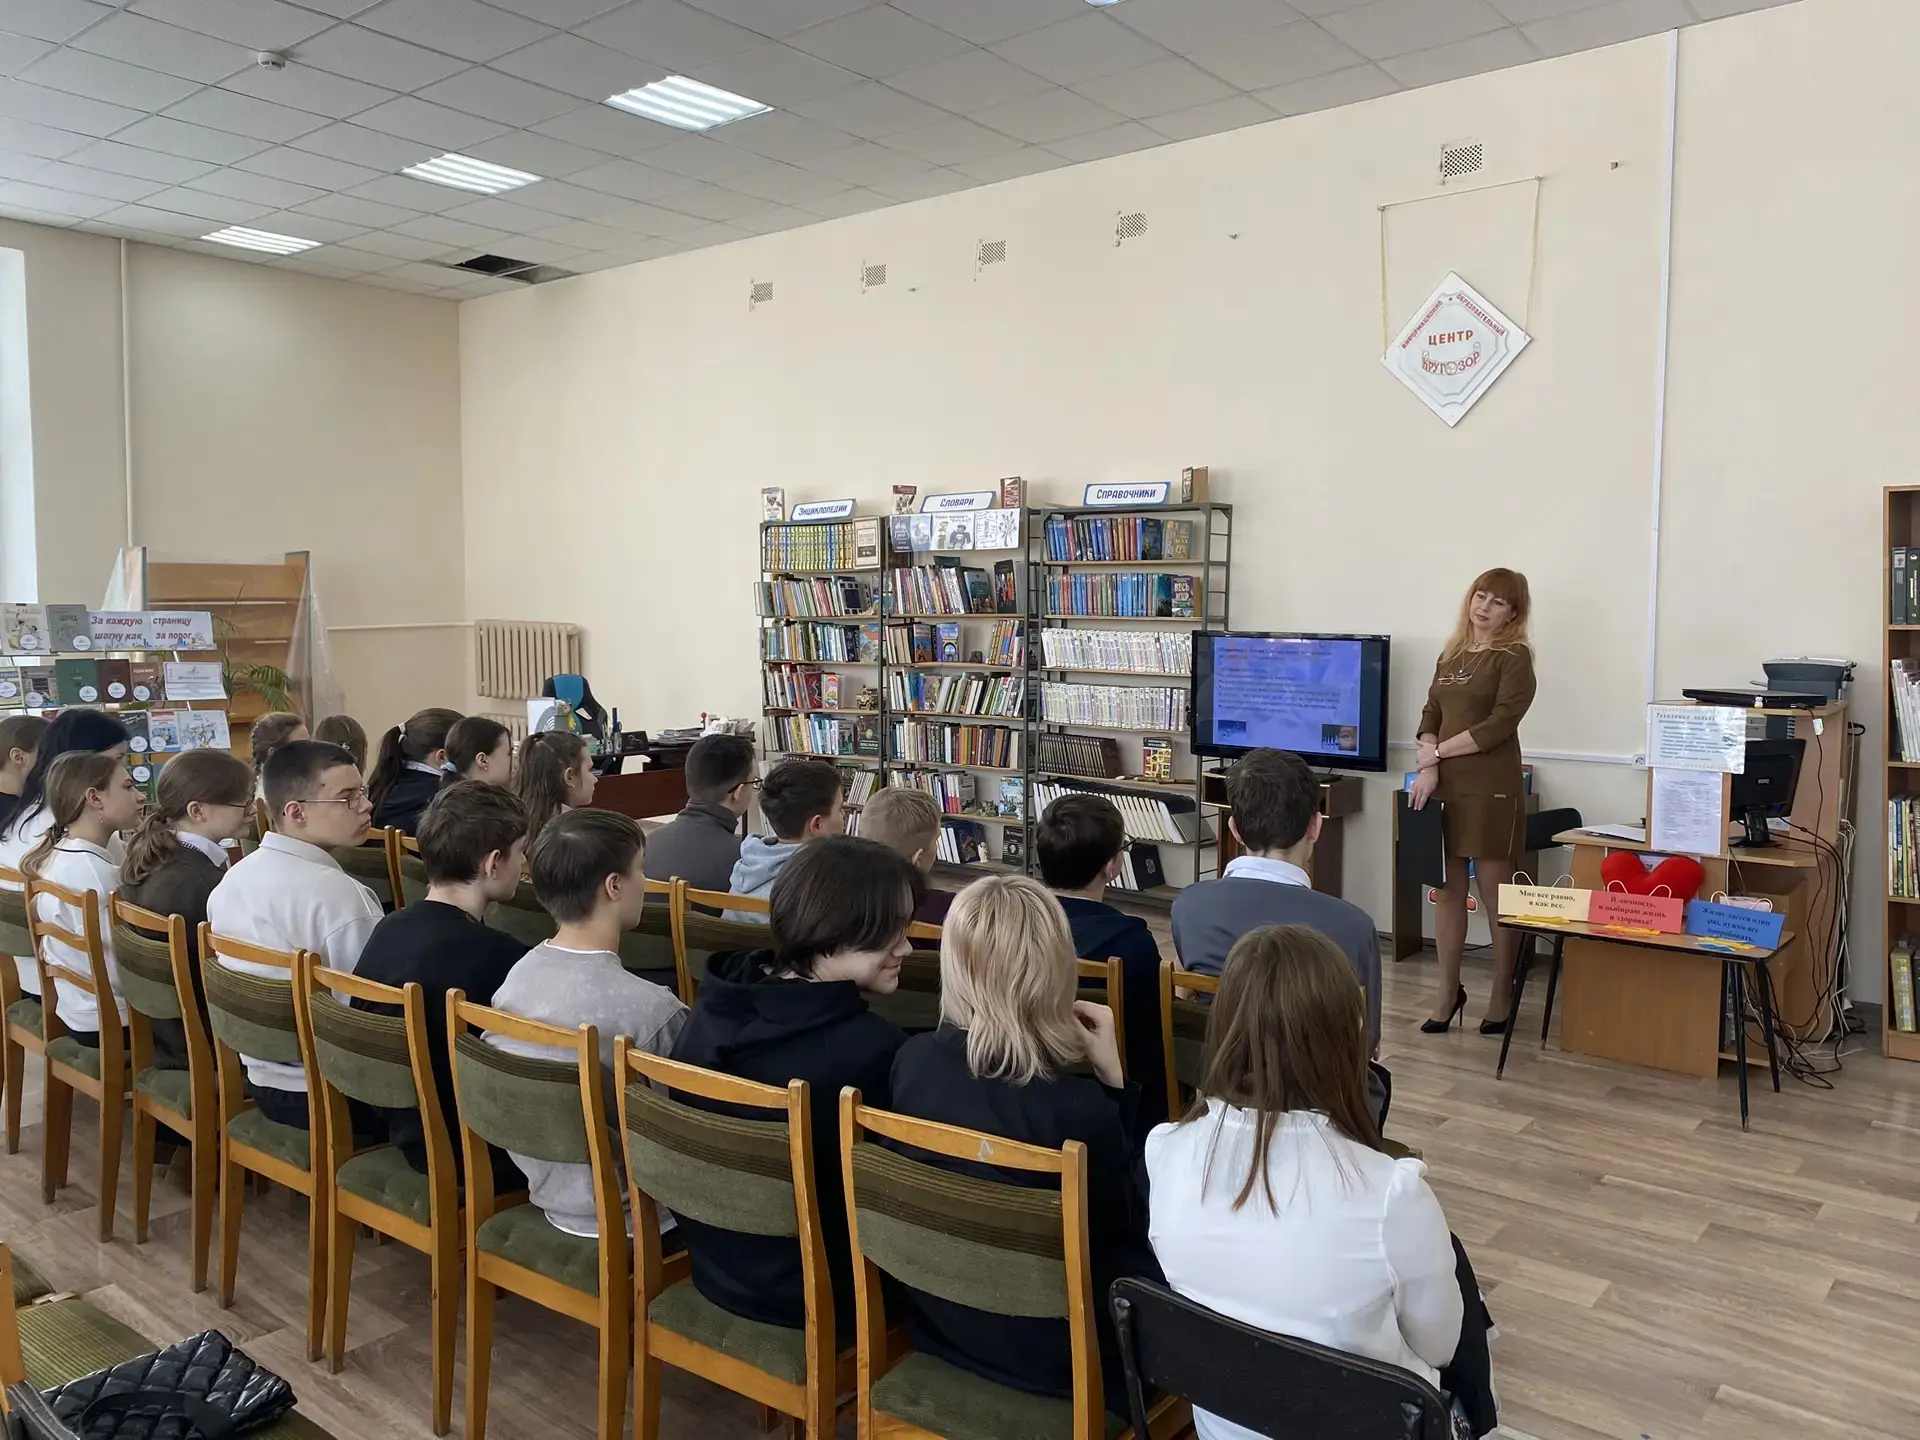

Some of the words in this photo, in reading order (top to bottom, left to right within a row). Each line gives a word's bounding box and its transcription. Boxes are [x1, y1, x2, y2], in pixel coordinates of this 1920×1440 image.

[1401, 300, 1443, 350] ИНФОРМАЦИОННО
[1456, 293, 1506, 337] ОБРАЗОВАТЕЛЬНЫЙ
[1428, 329, 1474, 347] ЦЕНТР
[91, 616, 104, 626] За
[105, 617, 143, 627] каждую
[152, 617, 192, 628] страницу
[94, 632, 124, 641] шагну
[125, 632, 143, 640] как
[155, 632, 166, 640] за
[167, 632, 192, 641] порог
[1519, 889, 1536, 898] Мне
[1550, 894, 1576, 902] равно,
